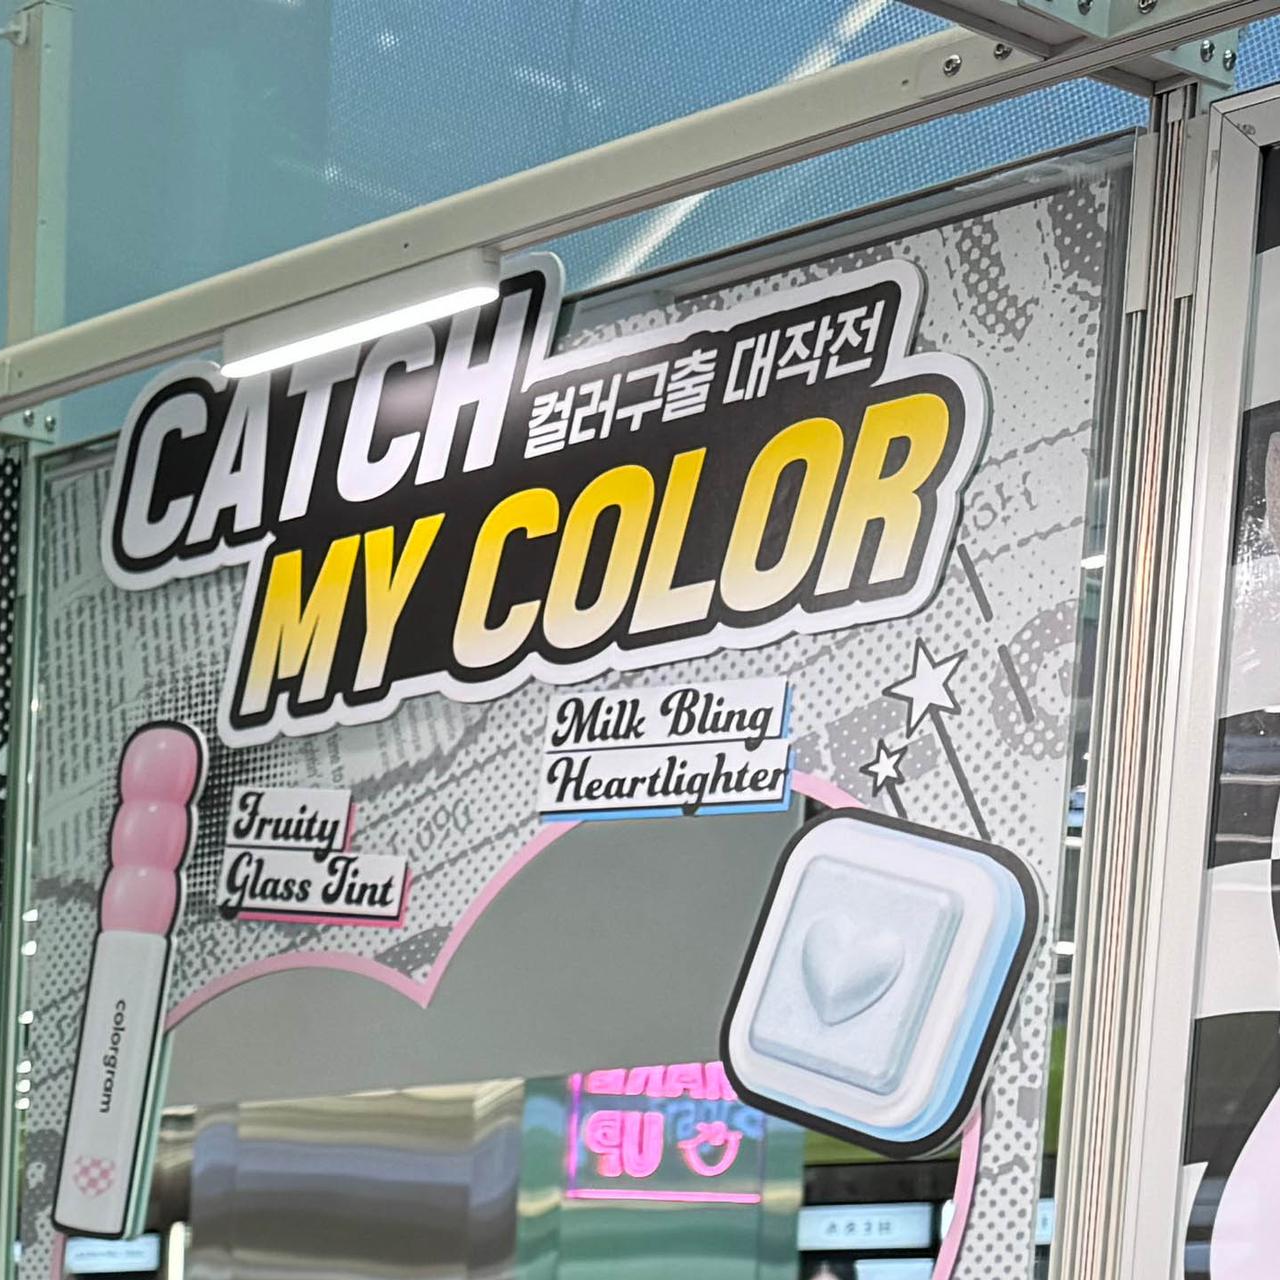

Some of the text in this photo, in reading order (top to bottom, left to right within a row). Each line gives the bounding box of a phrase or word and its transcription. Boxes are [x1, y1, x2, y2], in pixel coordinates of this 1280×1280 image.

[523, 299, 887, 459] 컬러구출 대작전
[120, 298, 518, 560] CATCH
[241, 513, 445, 717] MY
[452, 392, 950, 668] COLOR
[551, 686, 775, 746] Milk Bling
[233, 791, 341, 861] Fruity
[545, 754, 789, 816] Heartlighter
[220, 850, 396, 918] Glass Tint
[98, 999, 127, 1114] colorgram
